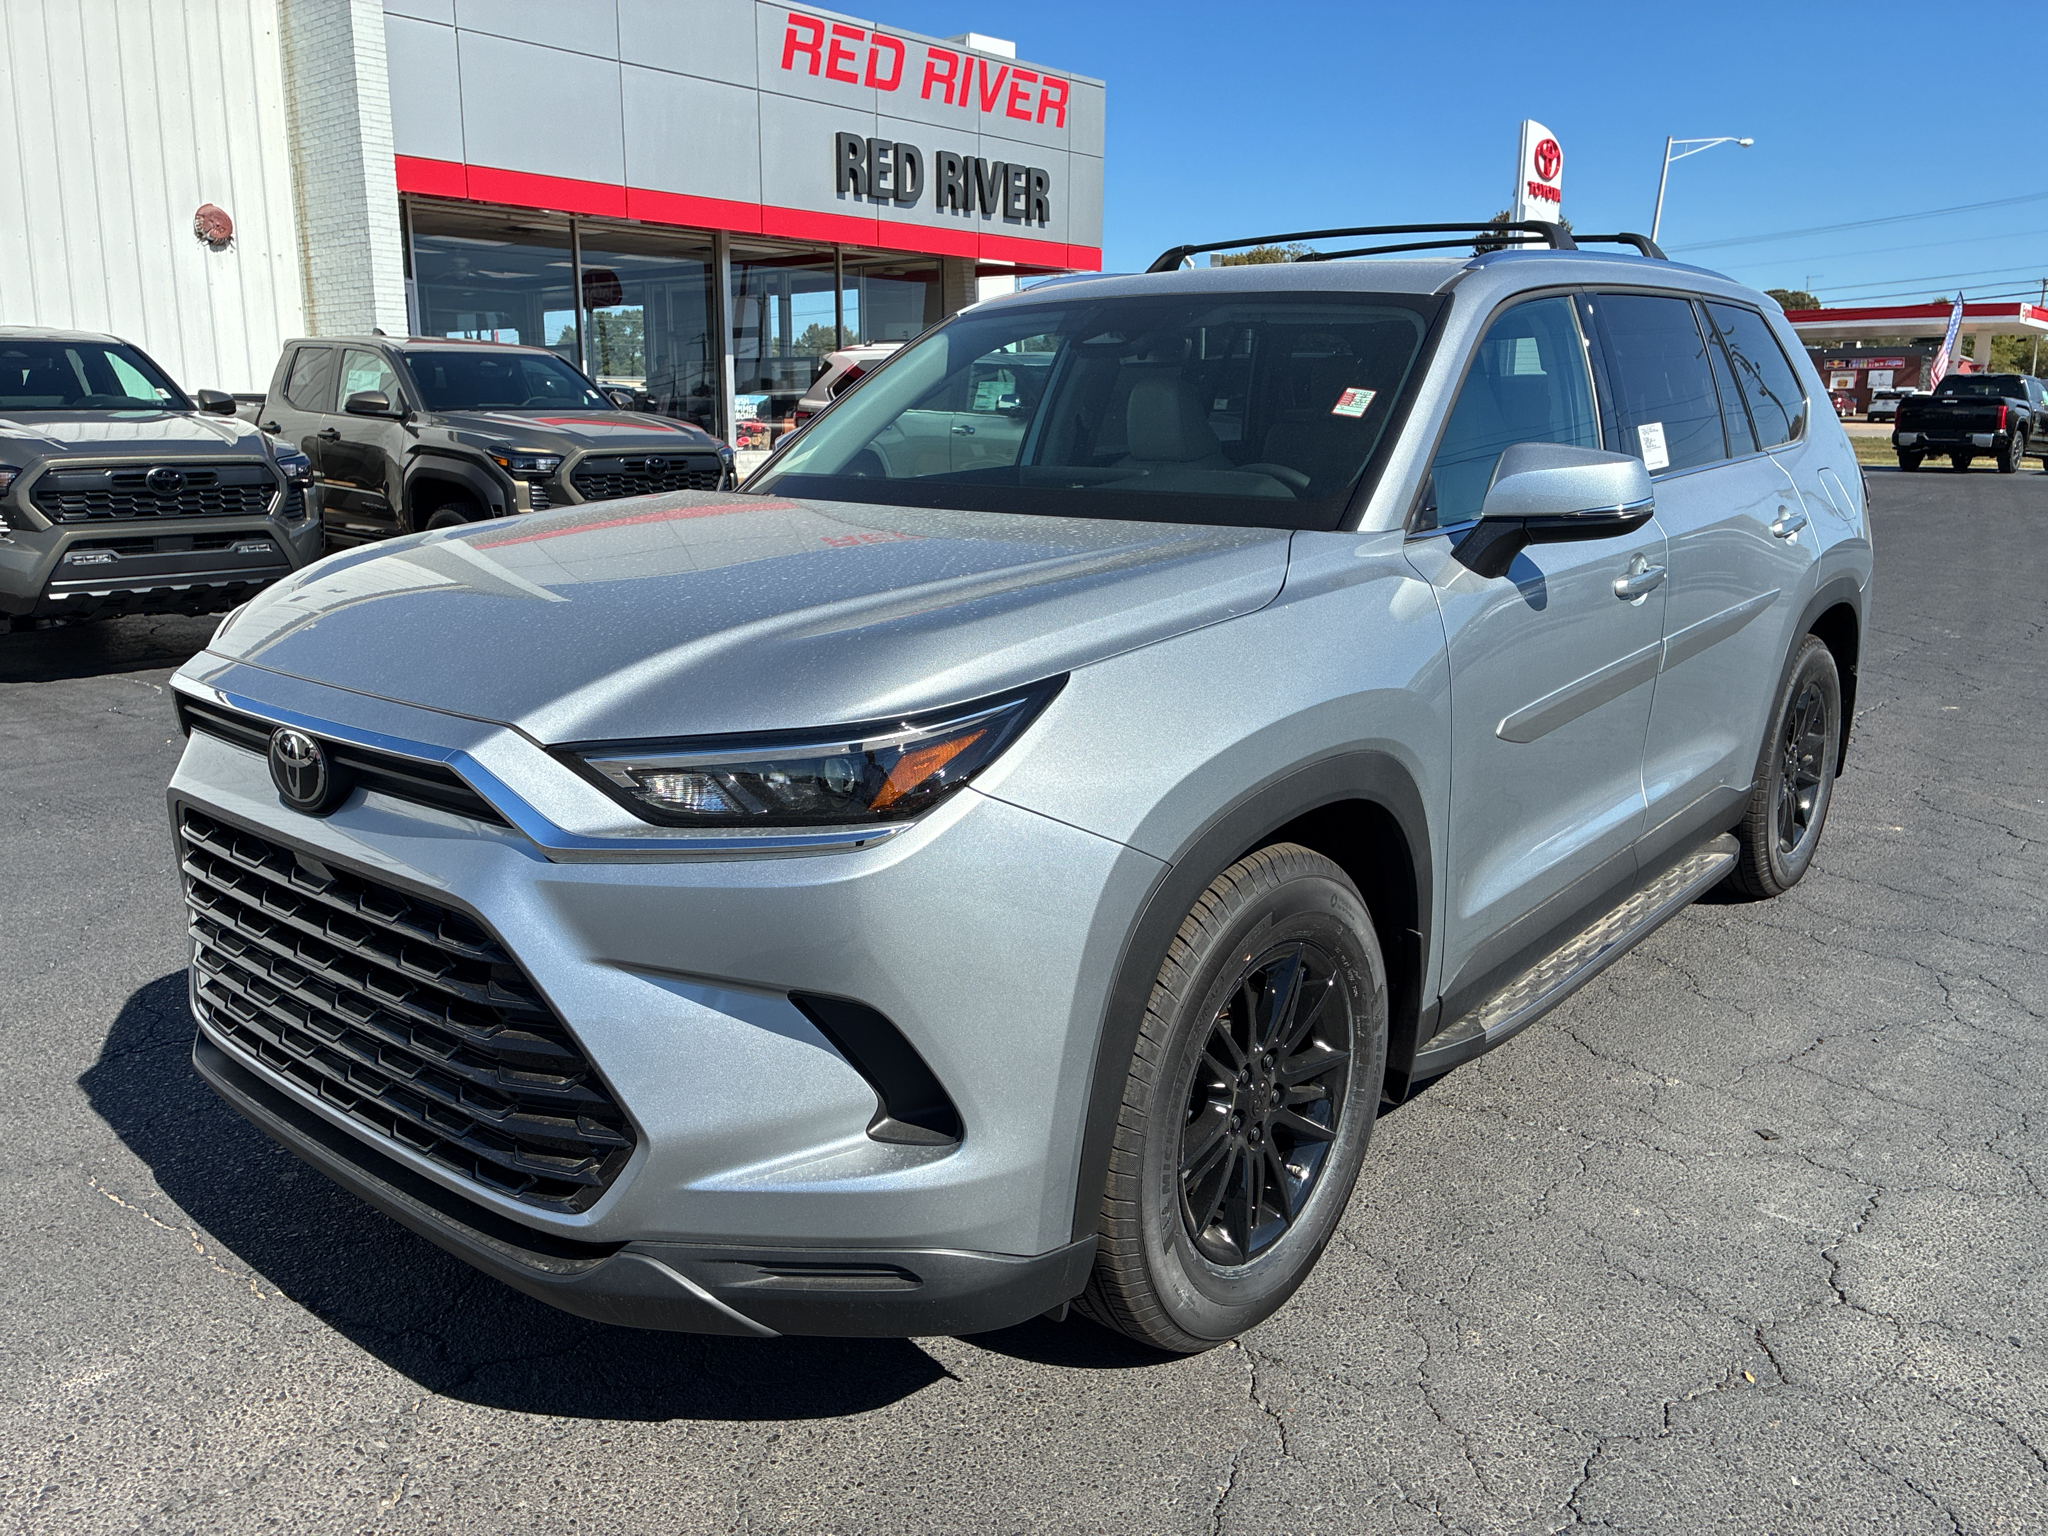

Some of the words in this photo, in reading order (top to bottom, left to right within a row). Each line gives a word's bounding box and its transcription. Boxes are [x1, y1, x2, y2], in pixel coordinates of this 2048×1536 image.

[781, 12, 906, 92] RED
[920, 46, 1070, 129] RIVER
[835, 131, 924, 202] RED
[936, 150, 1050, 223] RIVER
[1527, 181, 1561, 203] TOYOTA
